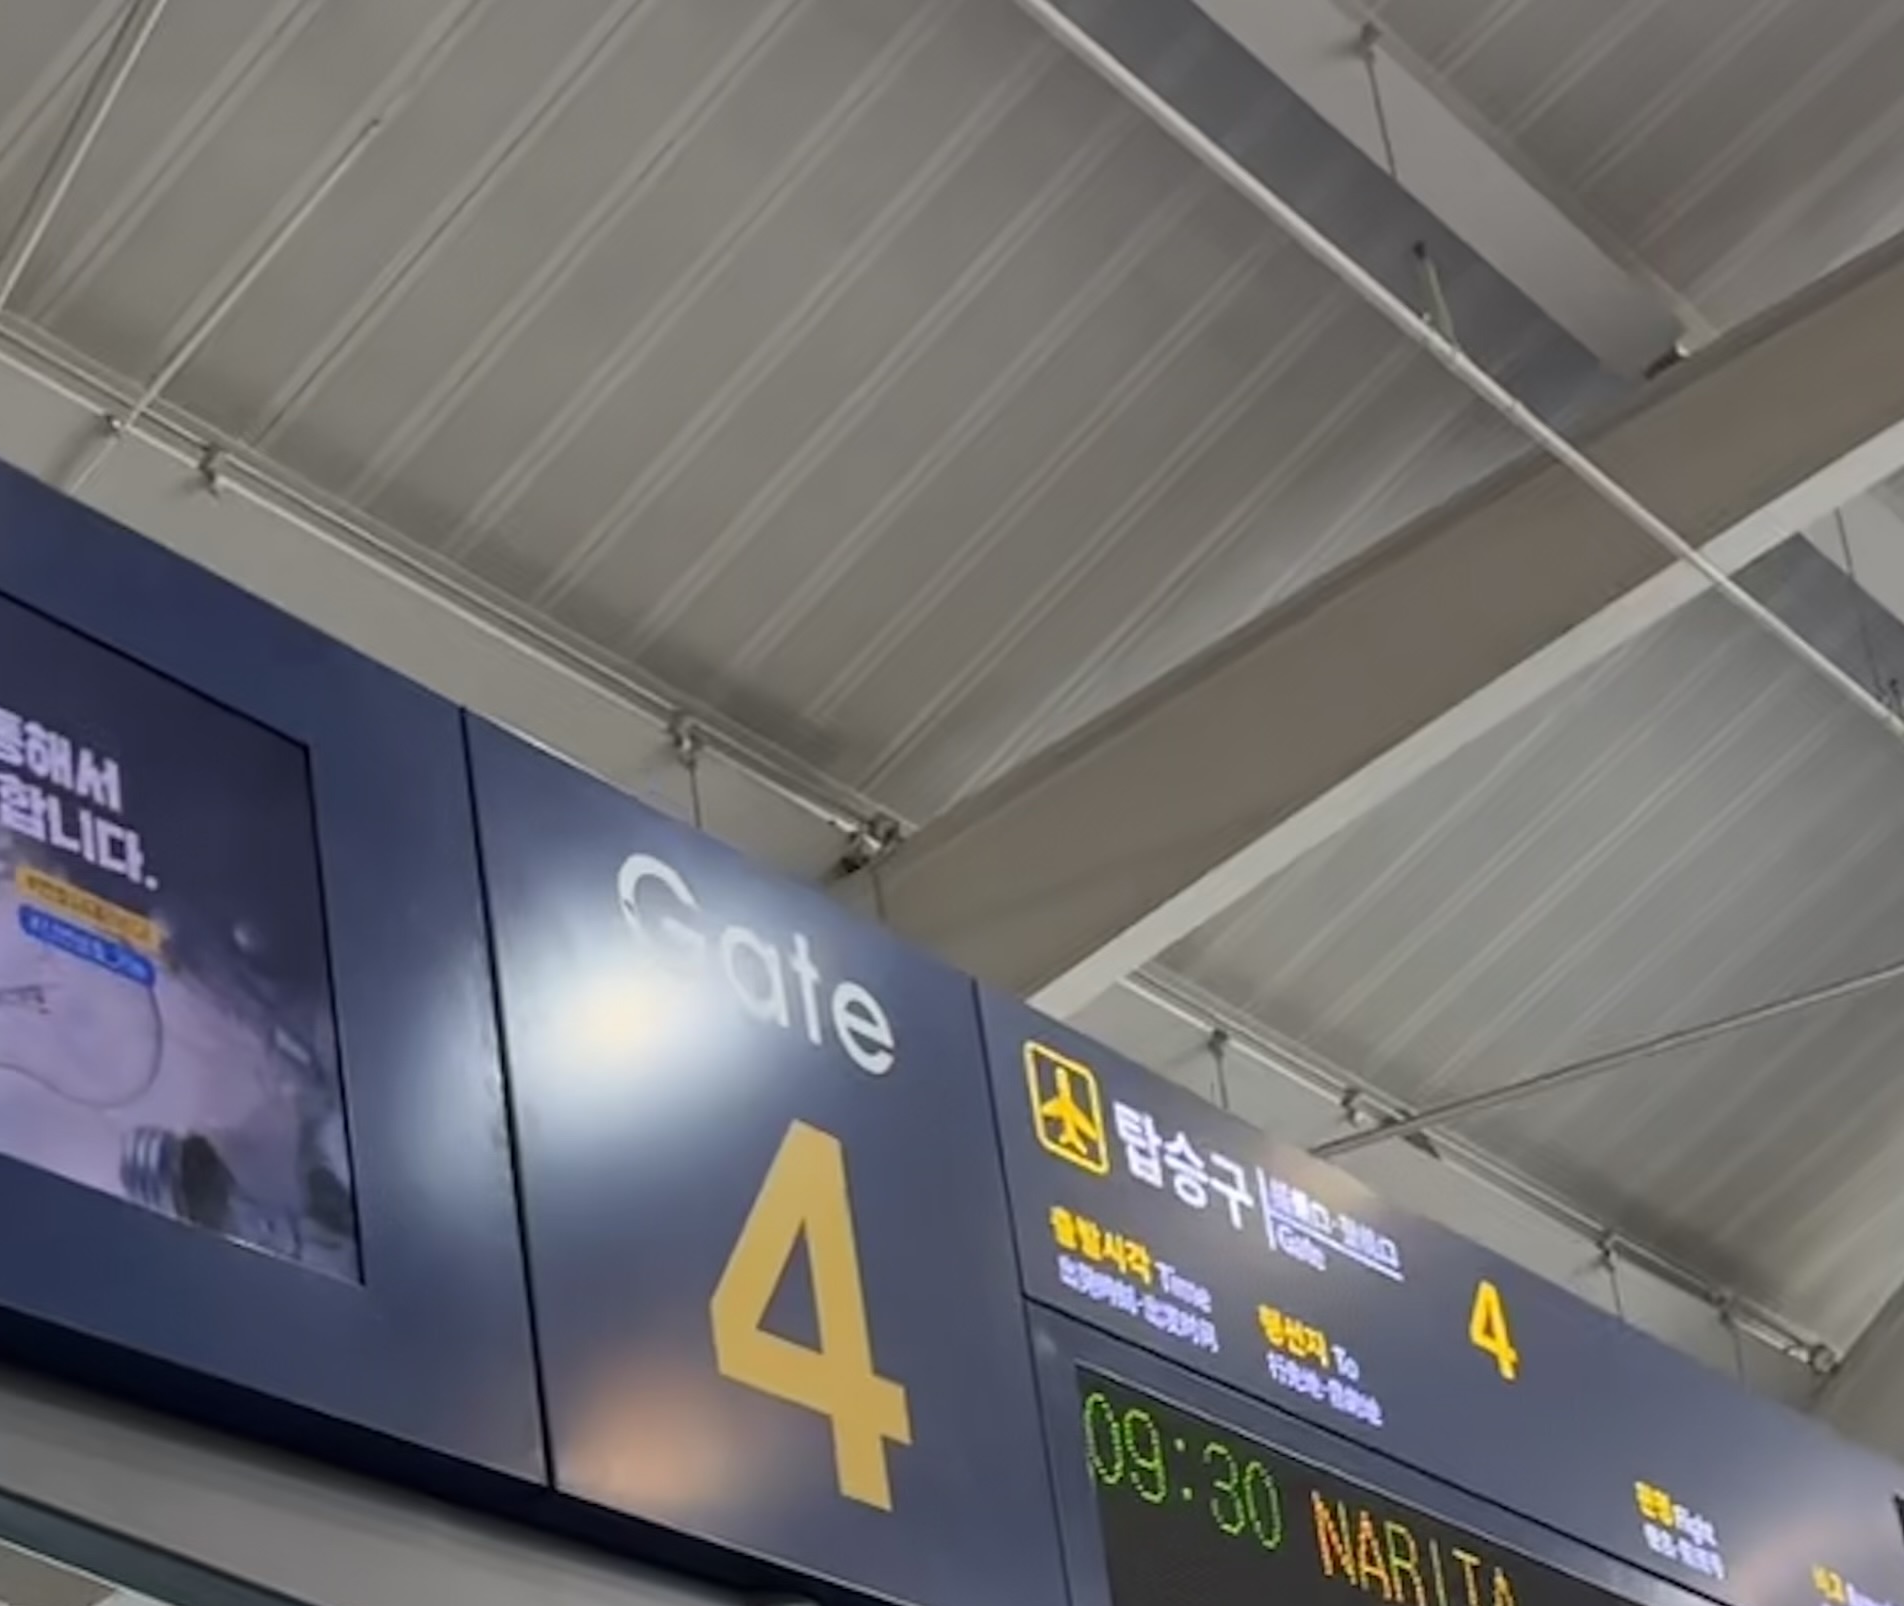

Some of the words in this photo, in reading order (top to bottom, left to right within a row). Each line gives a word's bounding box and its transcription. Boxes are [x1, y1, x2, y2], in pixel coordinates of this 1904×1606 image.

[616, 853, 897, 1076] Gate
[1112, 1099, 1256, 1231] 탑승구
[709, 1118, 913, 1513] 4
[1330, 1342, 1361, 1382] To
[1468, 1279, 1520, 1381] 4
[1083, 1392, 1282, 1550] 09:30
